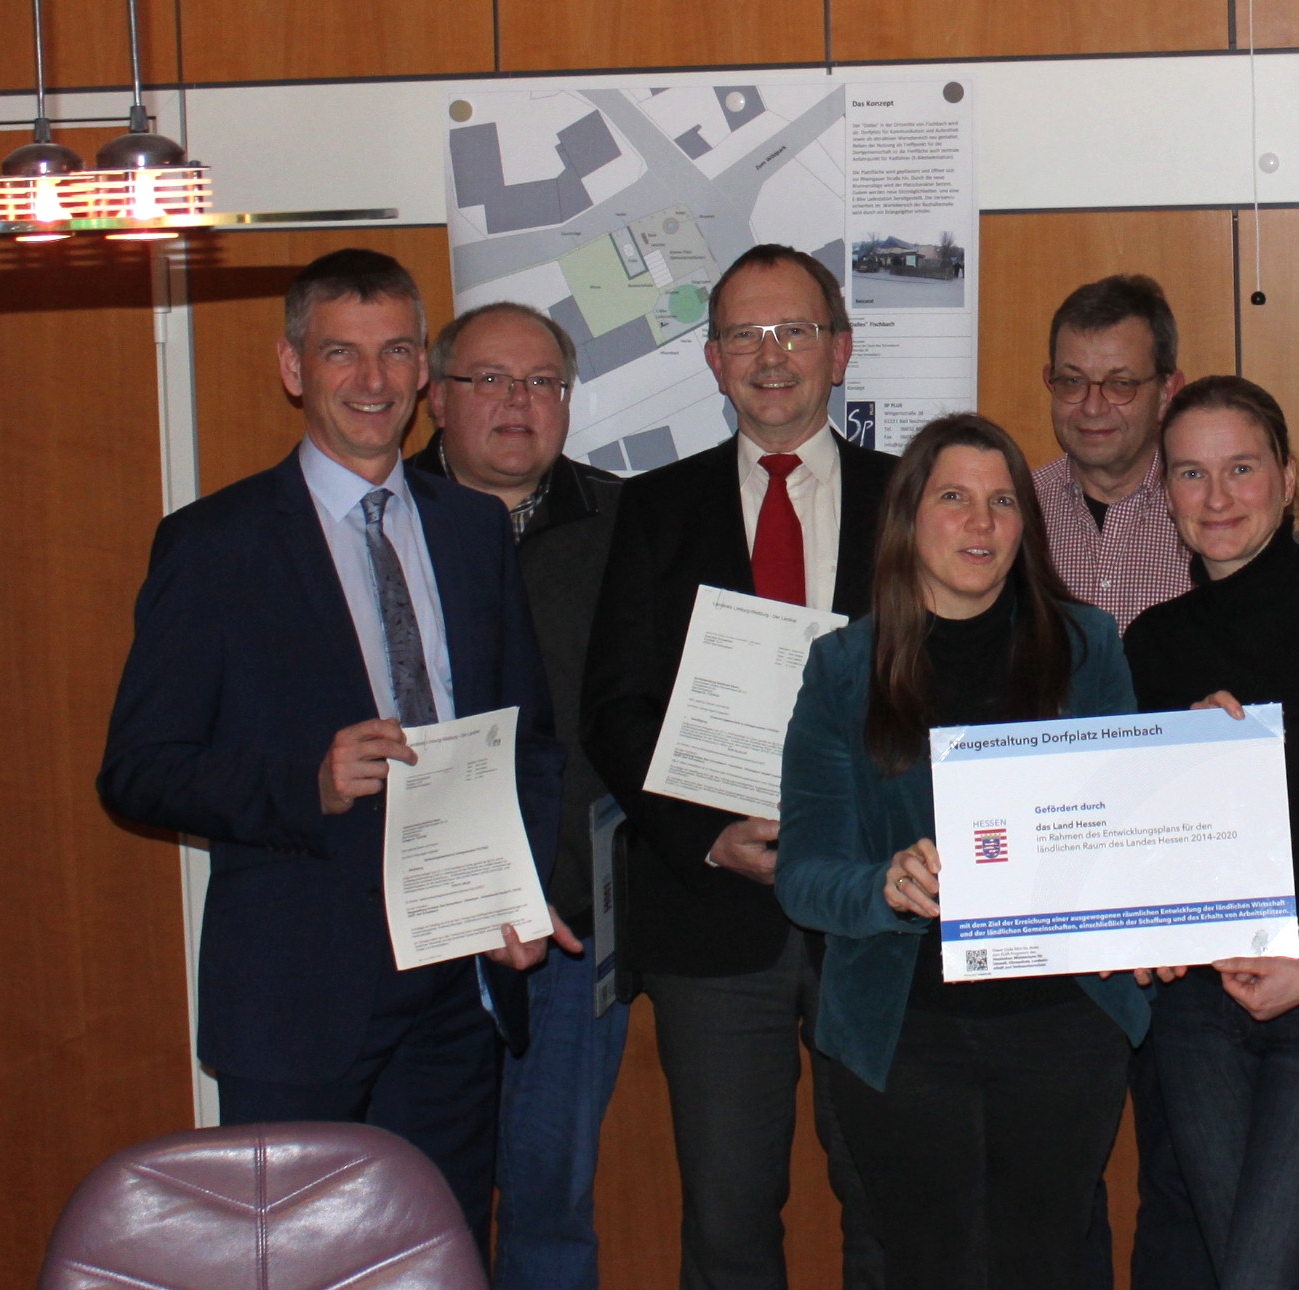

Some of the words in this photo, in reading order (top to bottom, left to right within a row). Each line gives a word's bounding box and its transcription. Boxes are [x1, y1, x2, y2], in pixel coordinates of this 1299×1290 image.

[950, 735, 1038, 751] Neugestaltung
[1042, 730, 1098, 744] Dorfplatz
[1101, 724, 1163, 739] Heimbach
[1035, 804, 1078, 814] Gefördert
[1081, 802, 1105, 810] durch
[973, 819, 1007, 828] HESSEN
[1036, 823, 1050, 831] das
[1053, 821, 1073, 830] Land
[1076, 820, 1106, 828] Hessen
[1036, 834, 1046, 842] im
[1049, 832, 1084, 842] Rahmen
[1086, 830, 1101, 840] des
[1102, 824, 1180, 838] Entwicklungsplans
[1182, 823, 1194, 832] für
[1196, 822, 1212, 830] den
[1036, 841, 1080, 854] ländlichen
[1083, 840, 1106, 850] Raum
[1108, 840, 1124, 848] des
[1126, 836, 1156, 847] Landes
[1158, 835, 1189, 844] Hessen
[1191, 830, 1238, 842] 2014-2020
[1015, 917, 1050, 926] Erreichung
[1160, 906, 1202, 914] Entwicklung
